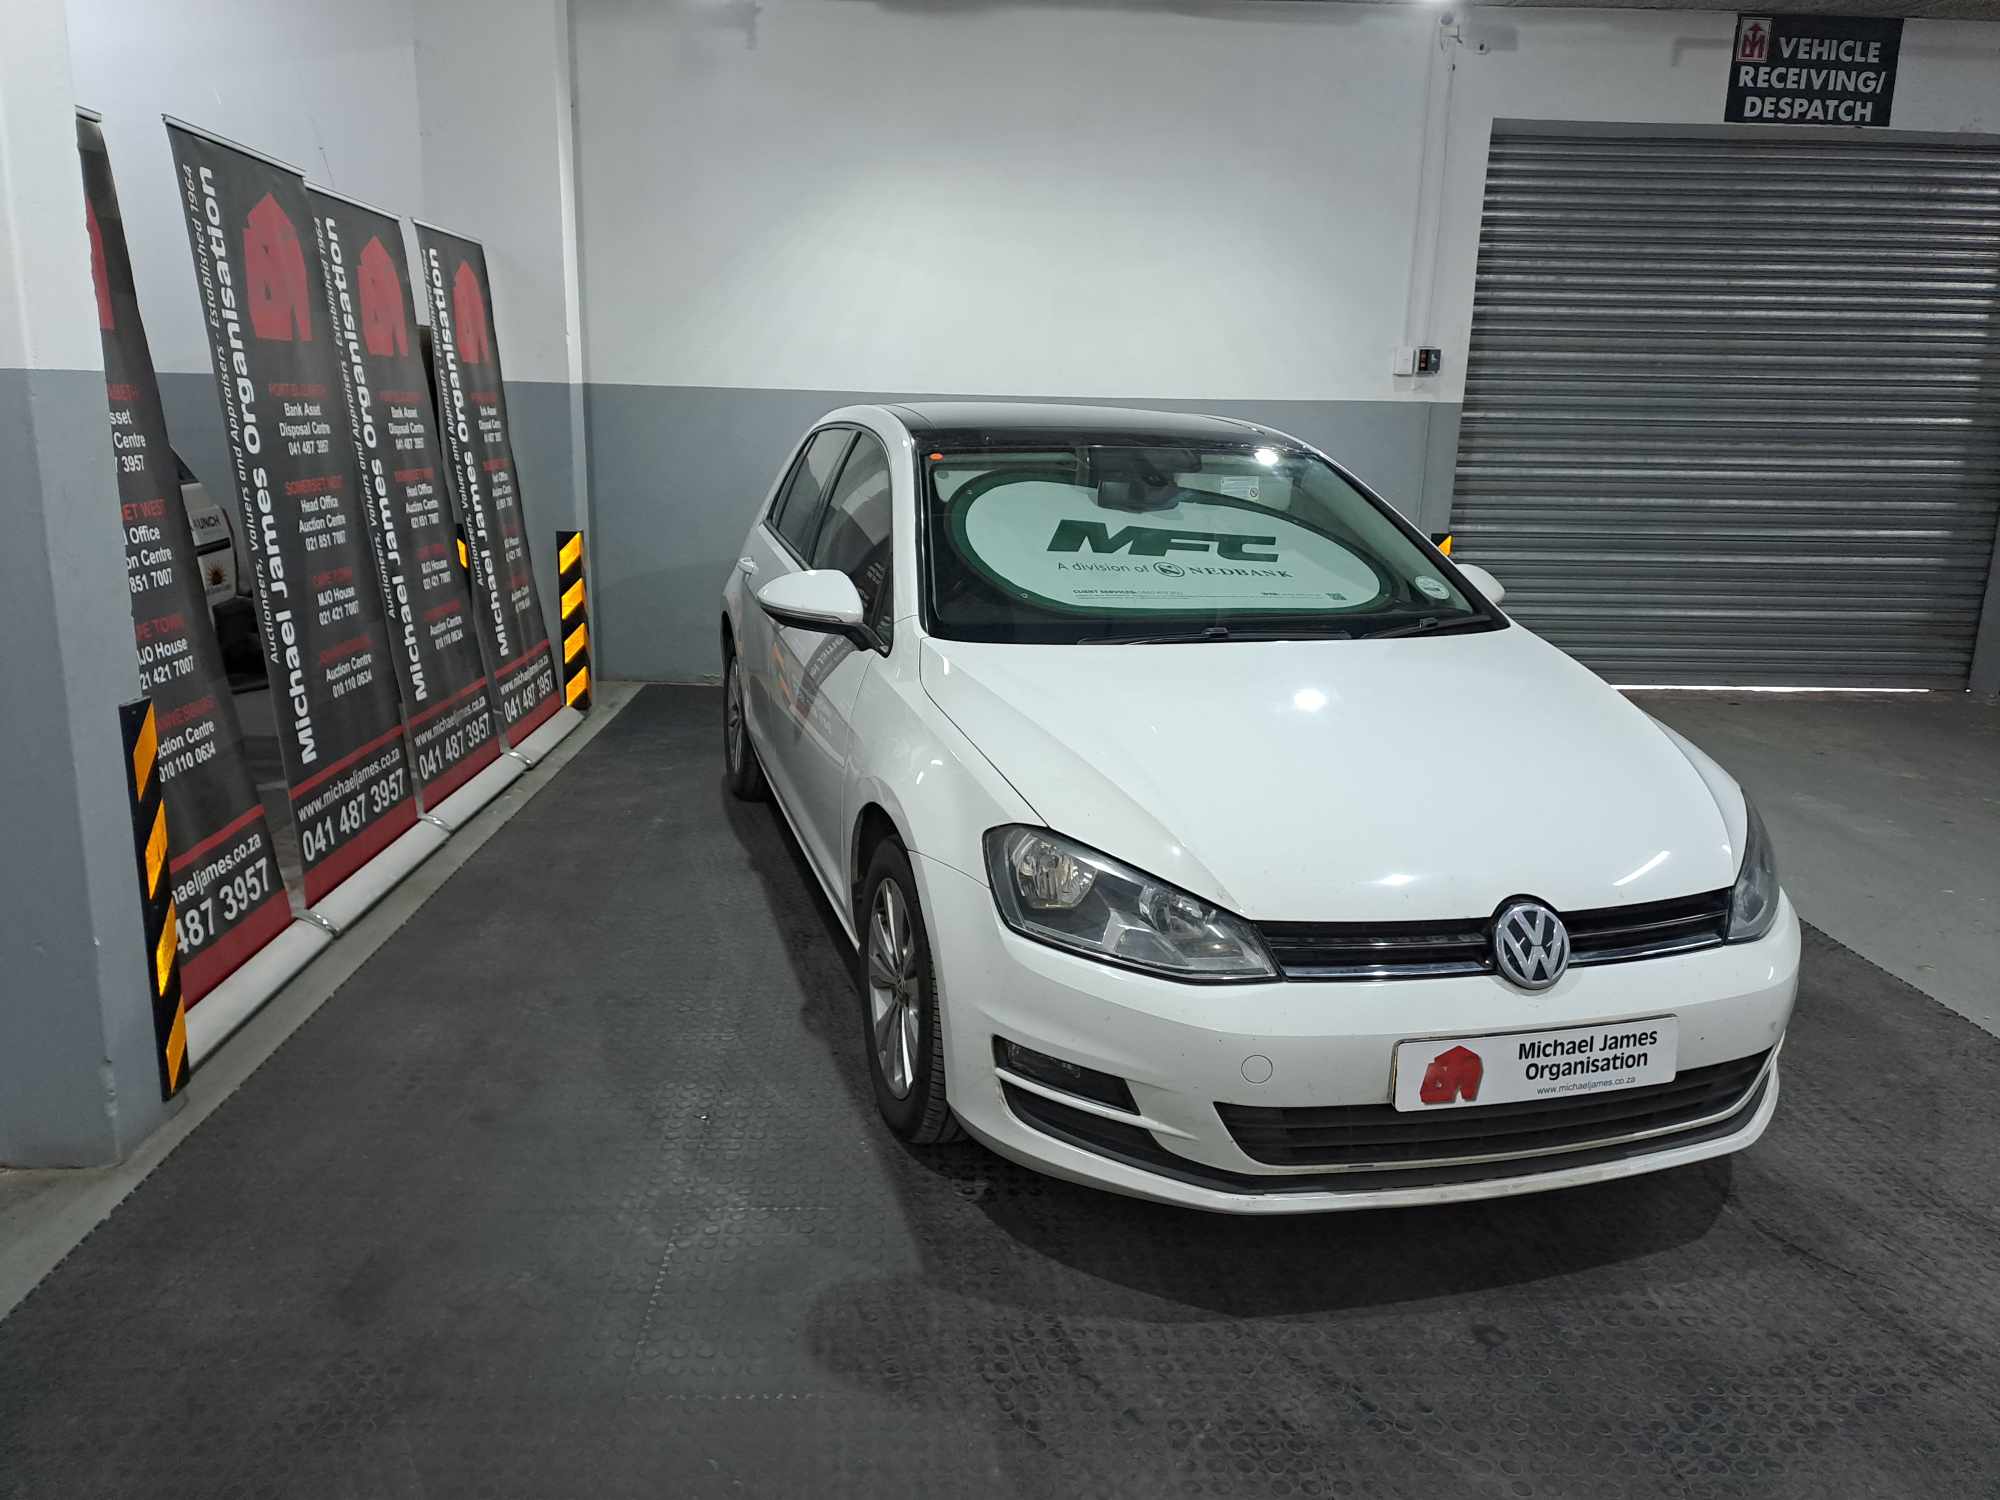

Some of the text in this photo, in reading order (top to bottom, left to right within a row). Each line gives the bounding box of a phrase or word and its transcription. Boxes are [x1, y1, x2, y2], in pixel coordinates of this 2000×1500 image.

[1779, 37, 1882, 63] VEHICLE
[1738, 65, 1887, 94] RECEIVING/
[1743, 96, 1873, 122] DESPATCH
[182, 163, 200, 212] 1964
[191, 218, 220, 329] Established
[429, 248, 469, 443] Organisation
[216, 346, 242, 442] Appraisers
[283, 402, 303, 416] Bank
[113, 431, 147, 449] Centre
[279, 421, 311, 439] Disposal
[121, 454, 145, 472] 3957
[199, 166, 318, 765] Michael James Organisation
[232, 445, 247, 482] and
[325, 217, 428, 702] Michael James Organisation
[464, 451, 488, 542] James
[241, 486, 259, 551] Valuers
[299, 517, 326, 533] Auction
[129, 525, 161, 544] Office
[1046, 519, 1278, 562] MFC
[141, 547, 173, 566] Centre
[1058, 562, 1068, 570] A
[1072, 562, 1130, 572] division
[1187, 566, 1294, 578] NEDBANK
[129, 567, 173, 593] 851 7007
[256, 558, 280, 664] Auctioneers,
[480, 549, 509, 657] Michael
[154, 638, 188, 659] House
[153, 664, 172, 684] 421
[172, 655, 194, 677] 7007
[326, 662, 351, 682] Auction
[503, 693, 522, 723] 041
[522, 683, 536, 709] 487
[185, 720, 215, 743] Centre
[419, 712, 490, 780] 041 487 3957
[176, 752, 194, 773] 110
[194, 740, 217, 763] 0634
[297, 748, 400, 822] www.michaeljames.co.za
[302, 767, 404, 862] 041 487 3957
[219, 857, 269, 921] 3957
[1518, 1030, 1658, 1060] Michael James
[1525, 1052, 1648, 1080] Organisation
[1536, 1076, 1636, 1095] www.michaeljames.co.za
